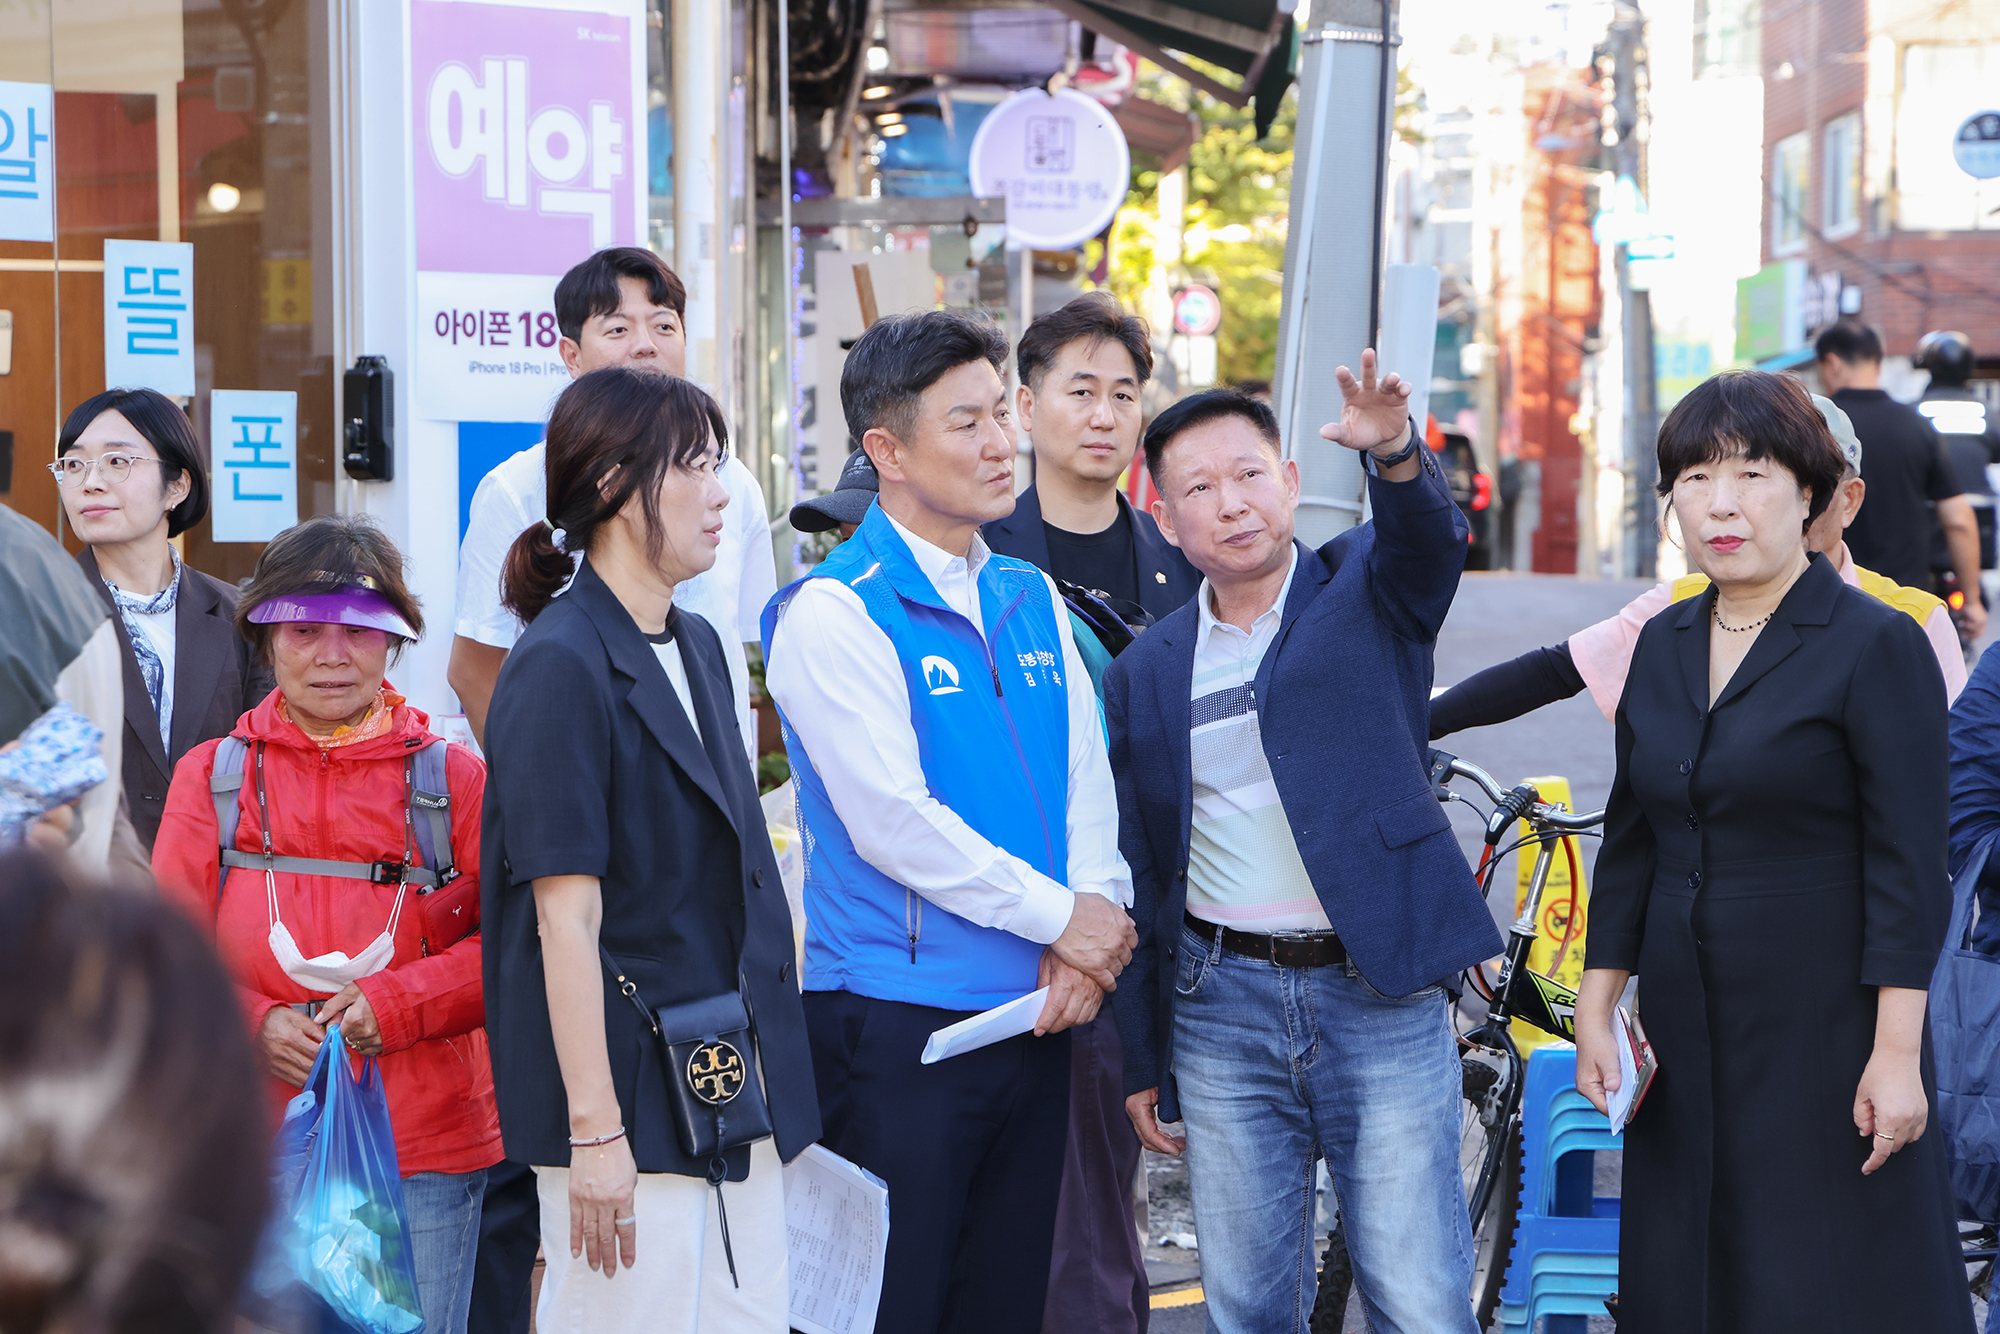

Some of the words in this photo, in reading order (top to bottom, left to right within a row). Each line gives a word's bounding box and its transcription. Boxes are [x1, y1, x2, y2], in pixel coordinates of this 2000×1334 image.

[576, 27, 591, 40] SK
[0, 107, 49, 199] 알
[427, 56, 625, 249] 예약
[117, 266, 187, 355] 뜰
[435, 309, 511, 346] 아이폰
[518, 311, 557, 348] 18
[469, 361, 506, 374] iPhone
[509, 362, 521, 374] 18
[523, 362, 541, 375] Pro
[550, 363, 567, 375] Pro
[223, 416, 291, 501] 폰
